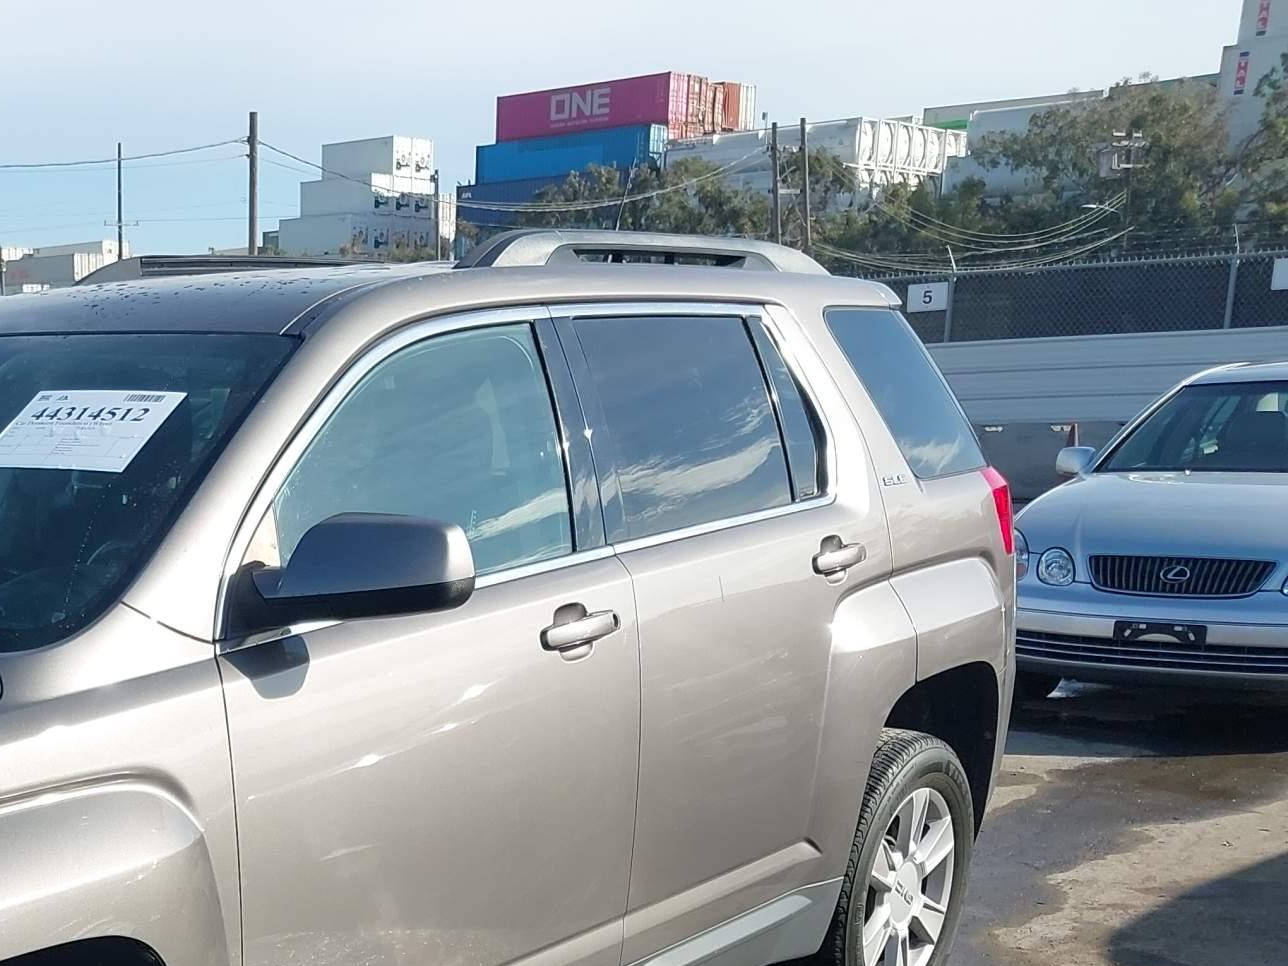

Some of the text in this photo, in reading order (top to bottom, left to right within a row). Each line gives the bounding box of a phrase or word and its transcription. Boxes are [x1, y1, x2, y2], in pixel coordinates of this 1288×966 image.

[550, 88, 611, 121] ONE
[922, 290, 933, 304] 5
[31, 406, 151, 422] 44314512
